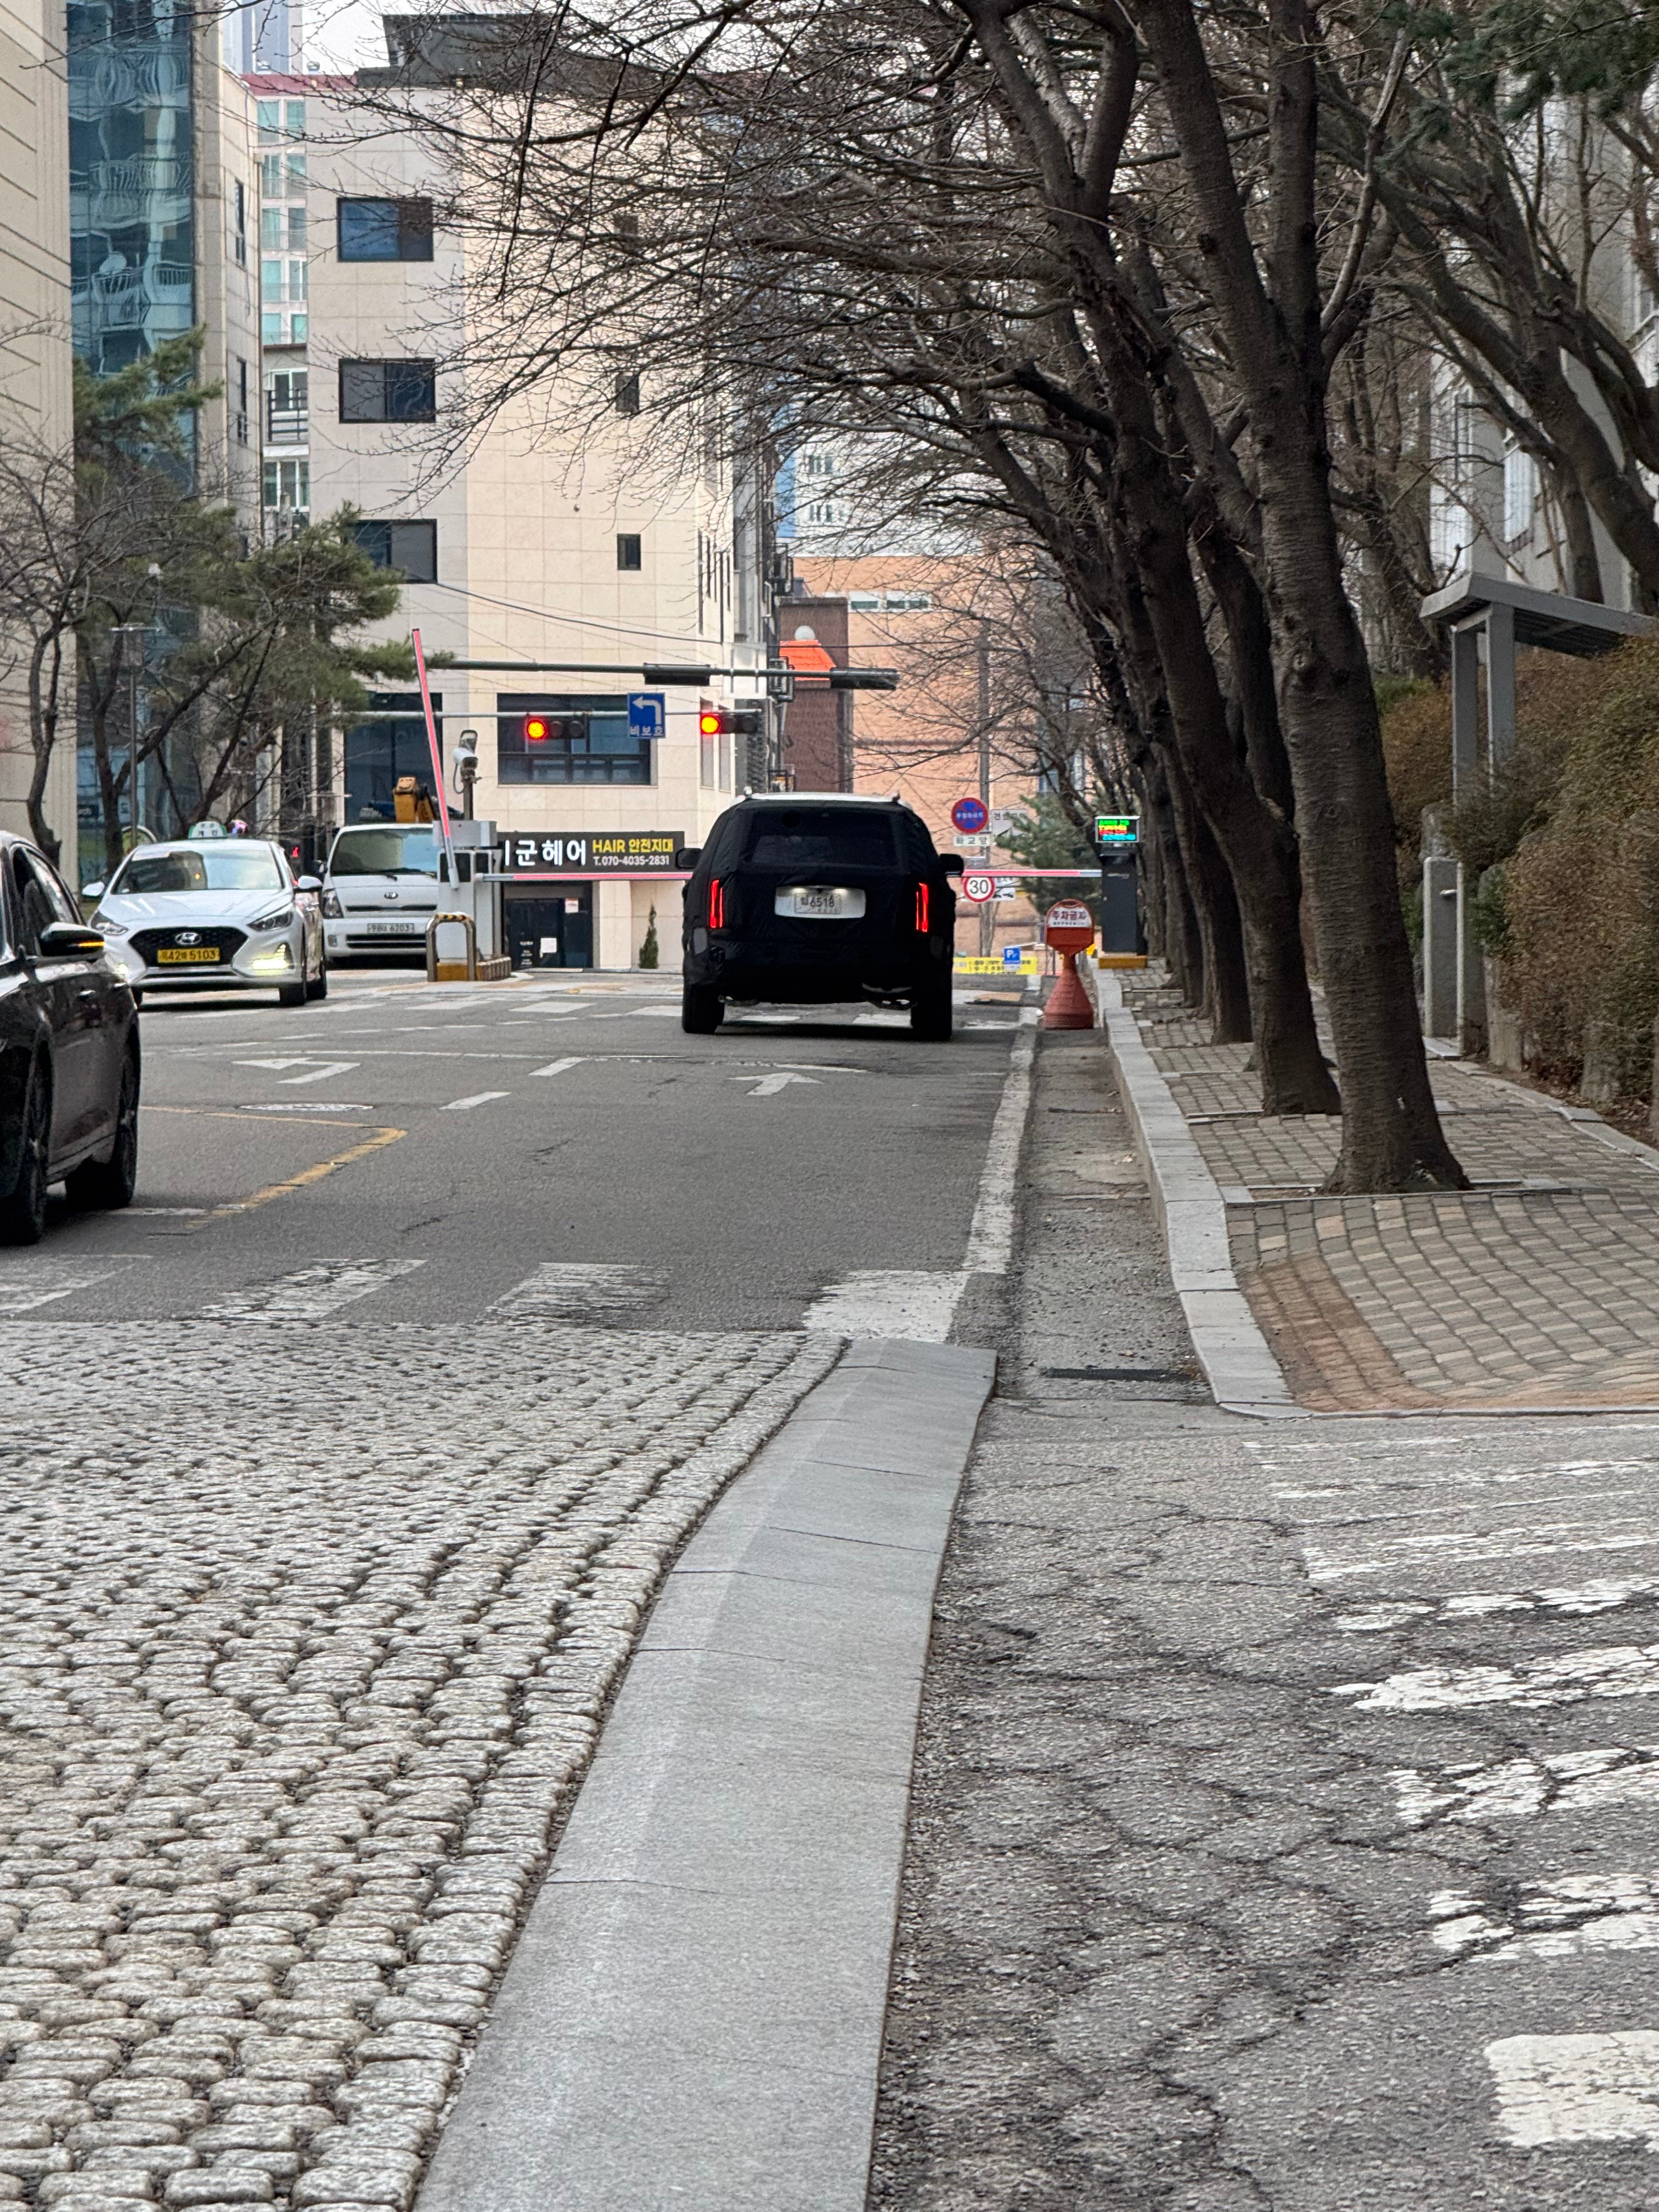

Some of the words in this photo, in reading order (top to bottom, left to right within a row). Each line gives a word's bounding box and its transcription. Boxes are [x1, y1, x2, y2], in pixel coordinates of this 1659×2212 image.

[630, 725, 663, 736] 비보호
[592, 839, 625, 853] HAIR
[628, 838, 674, 853] 안전지대
[593, 855, 669, 866] T.070-4035-2831
[969, 879, 989, 894] 30
[190, 950, 216, 960] 5103
